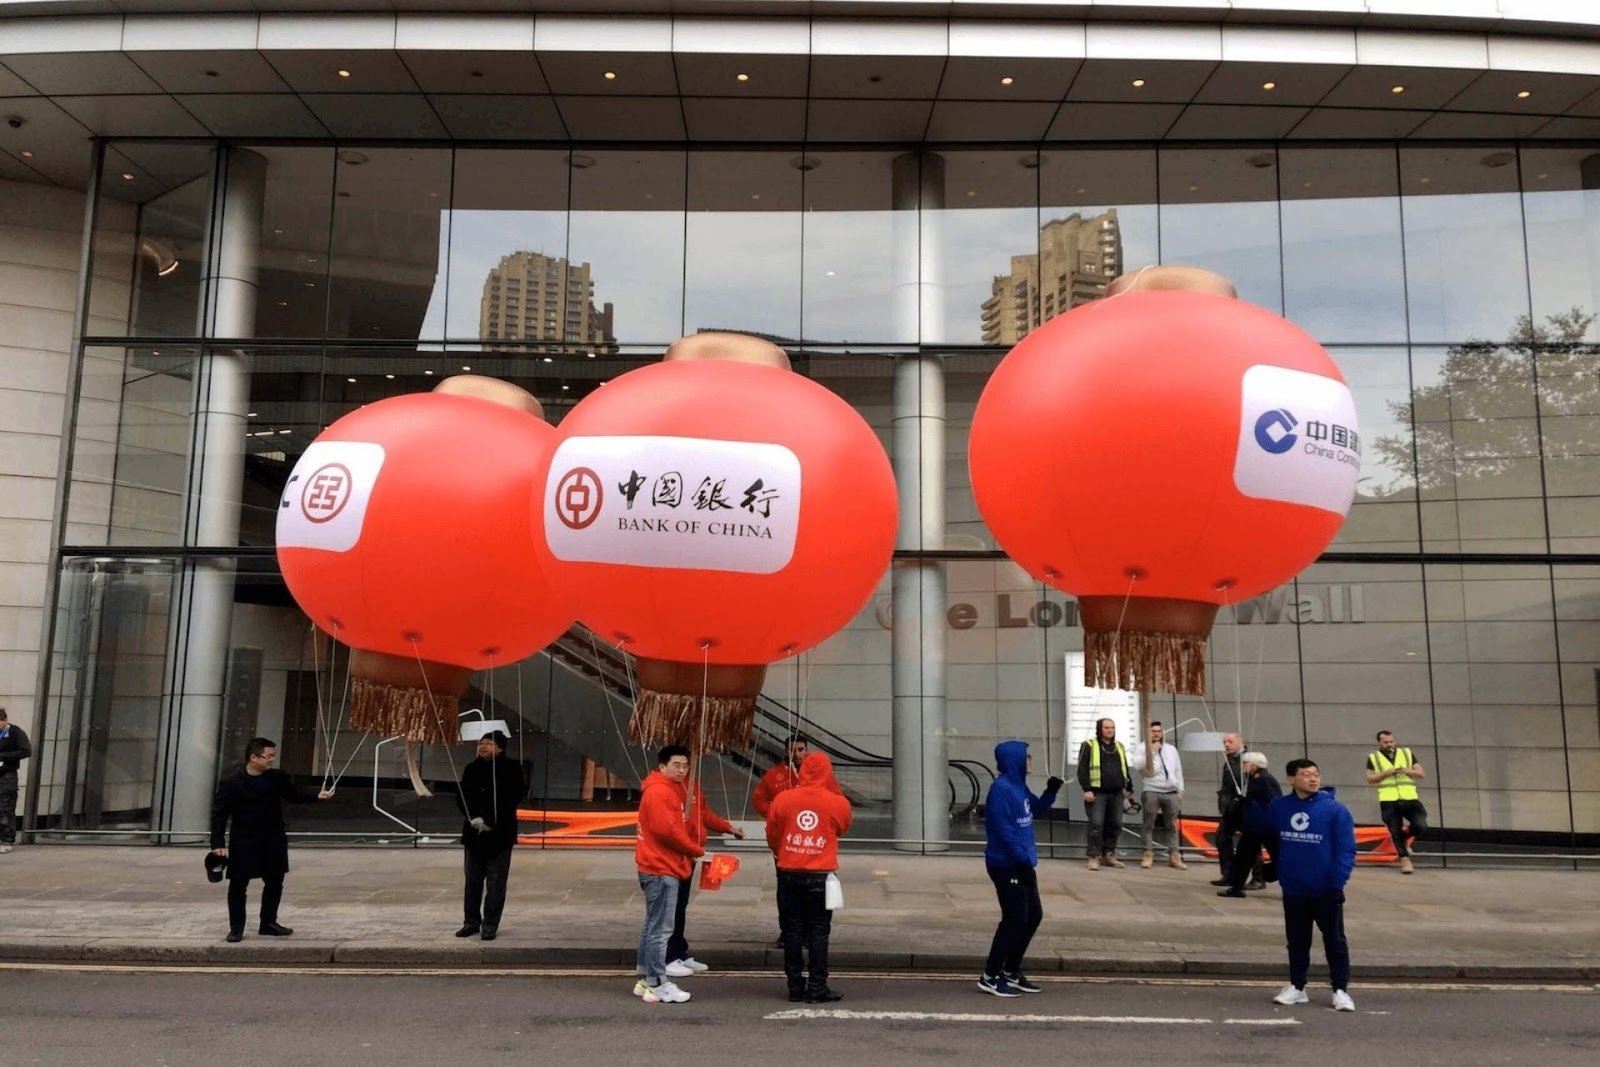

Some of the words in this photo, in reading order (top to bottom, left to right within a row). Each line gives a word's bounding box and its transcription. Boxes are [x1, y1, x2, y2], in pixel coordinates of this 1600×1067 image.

[1304, 442, 1334, 459] China
[618, 470, 780, 518] 中國銀行
[618, 517, 669, 532] BANK
[675, 520, 701, 534] OF
[708, 522, 773, 539] CHINA
